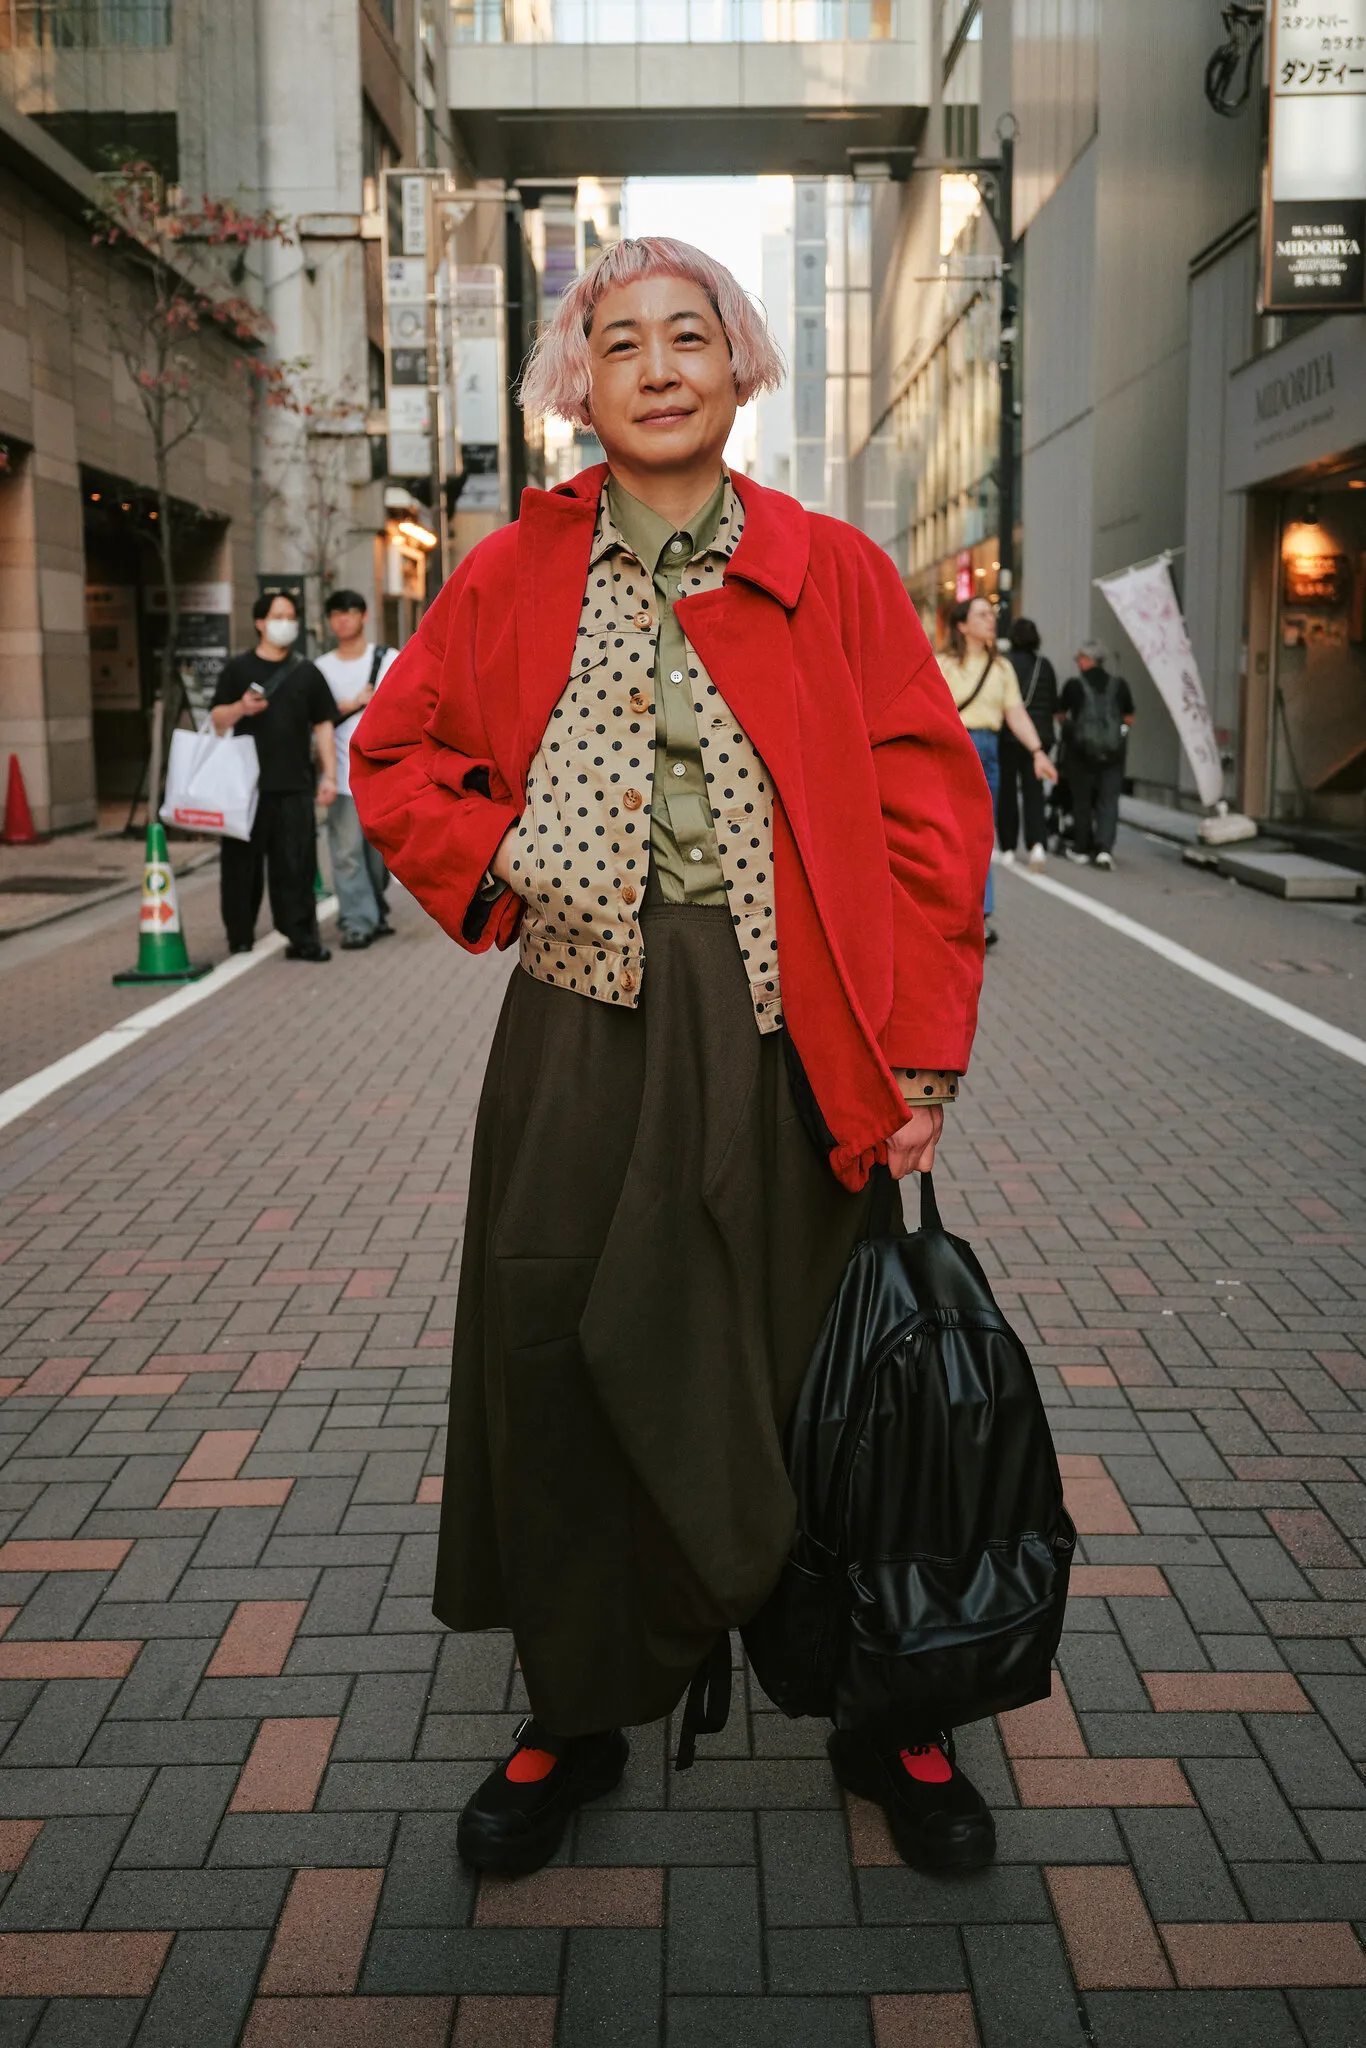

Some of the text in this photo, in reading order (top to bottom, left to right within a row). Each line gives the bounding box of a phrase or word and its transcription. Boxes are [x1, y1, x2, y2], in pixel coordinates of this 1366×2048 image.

[1281, 58, 1364, 85] ダンディー
[1276, 239, 1361, 256] MIDORIYA
[1254, 350, 1335, 426] MIDORIYA
